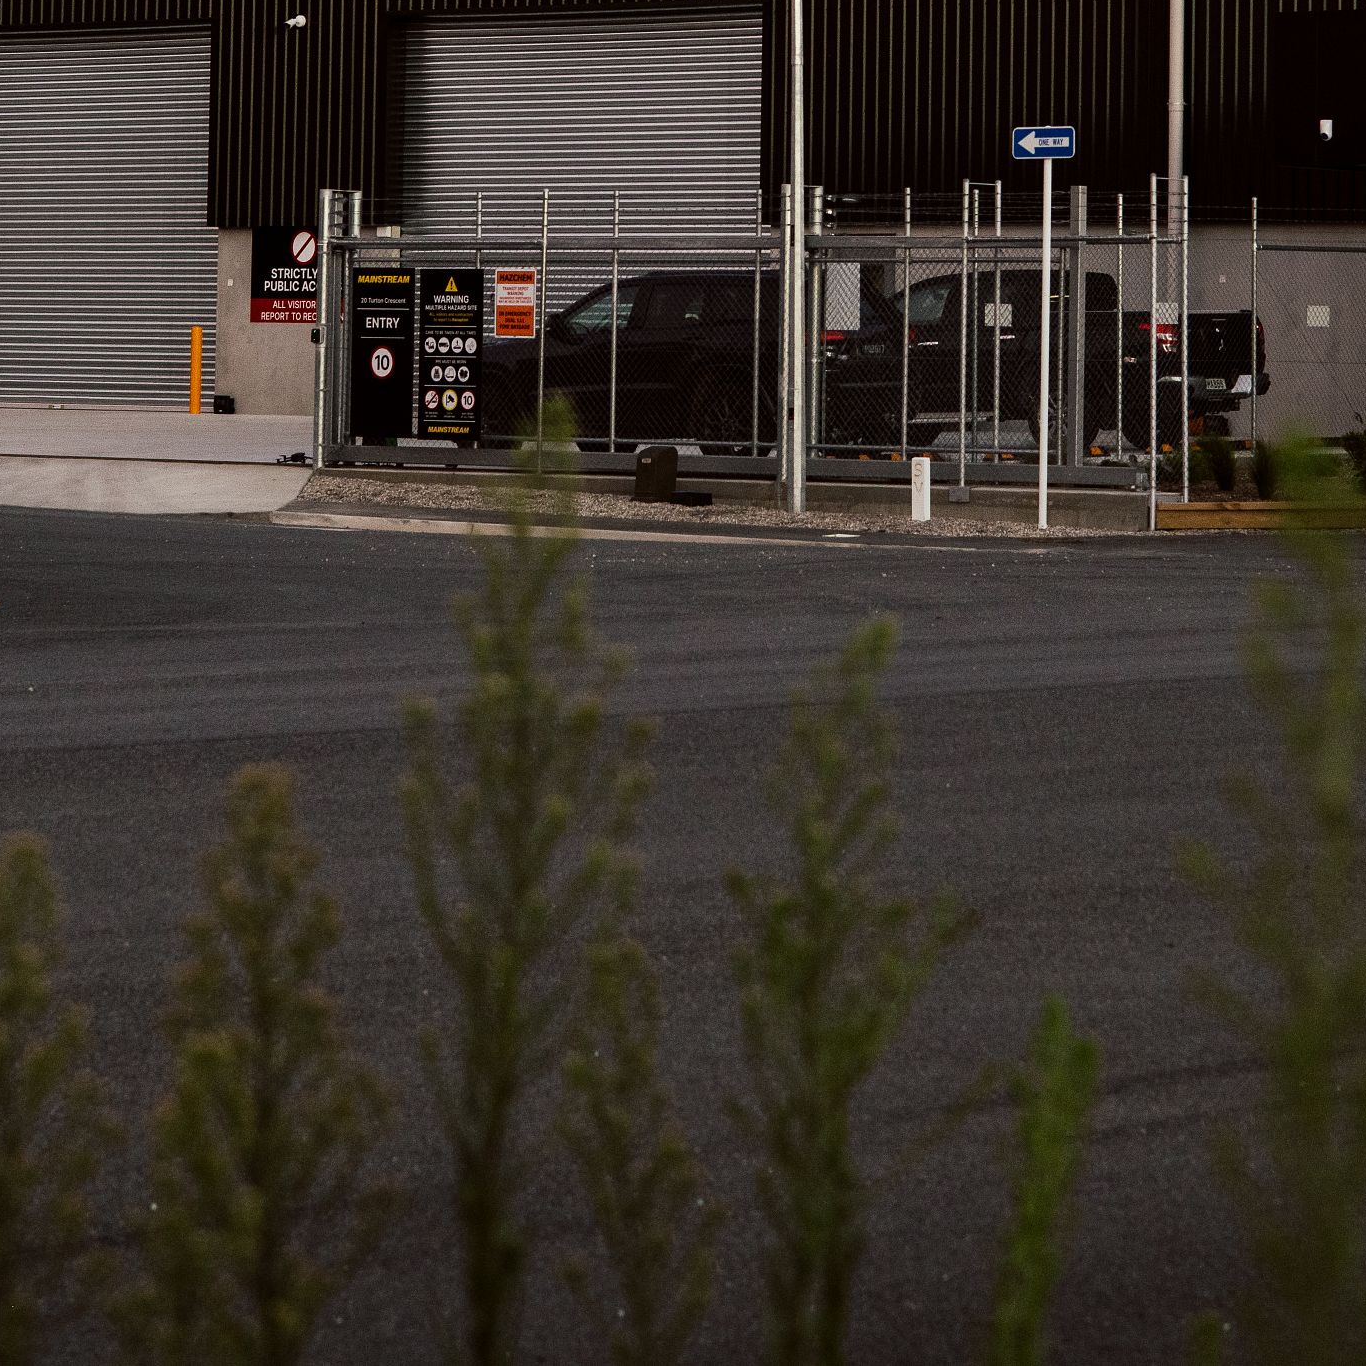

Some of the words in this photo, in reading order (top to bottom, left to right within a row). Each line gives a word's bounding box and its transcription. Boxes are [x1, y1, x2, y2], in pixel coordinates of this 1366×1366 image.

[271, 268, 318, 279] STRICTLY
[357, 275, 410, 284] MAINSTREAM
[264, 280, 299, 292] PUBLIC
[272, 300, 286, 309] ALL
[288, 300, 317, 309] VISITOR
[433, 295, 469, 304] WARNING
[260, 311, 290, 321] REPORT
[291, 312, 301, 321] TO
[365, 317, 400, 329] ENTRY
[375, 355, 390, 370] 10
[463, 395, 473, 406] 10
[427, 426, 470, 434] MAINSTREAM
